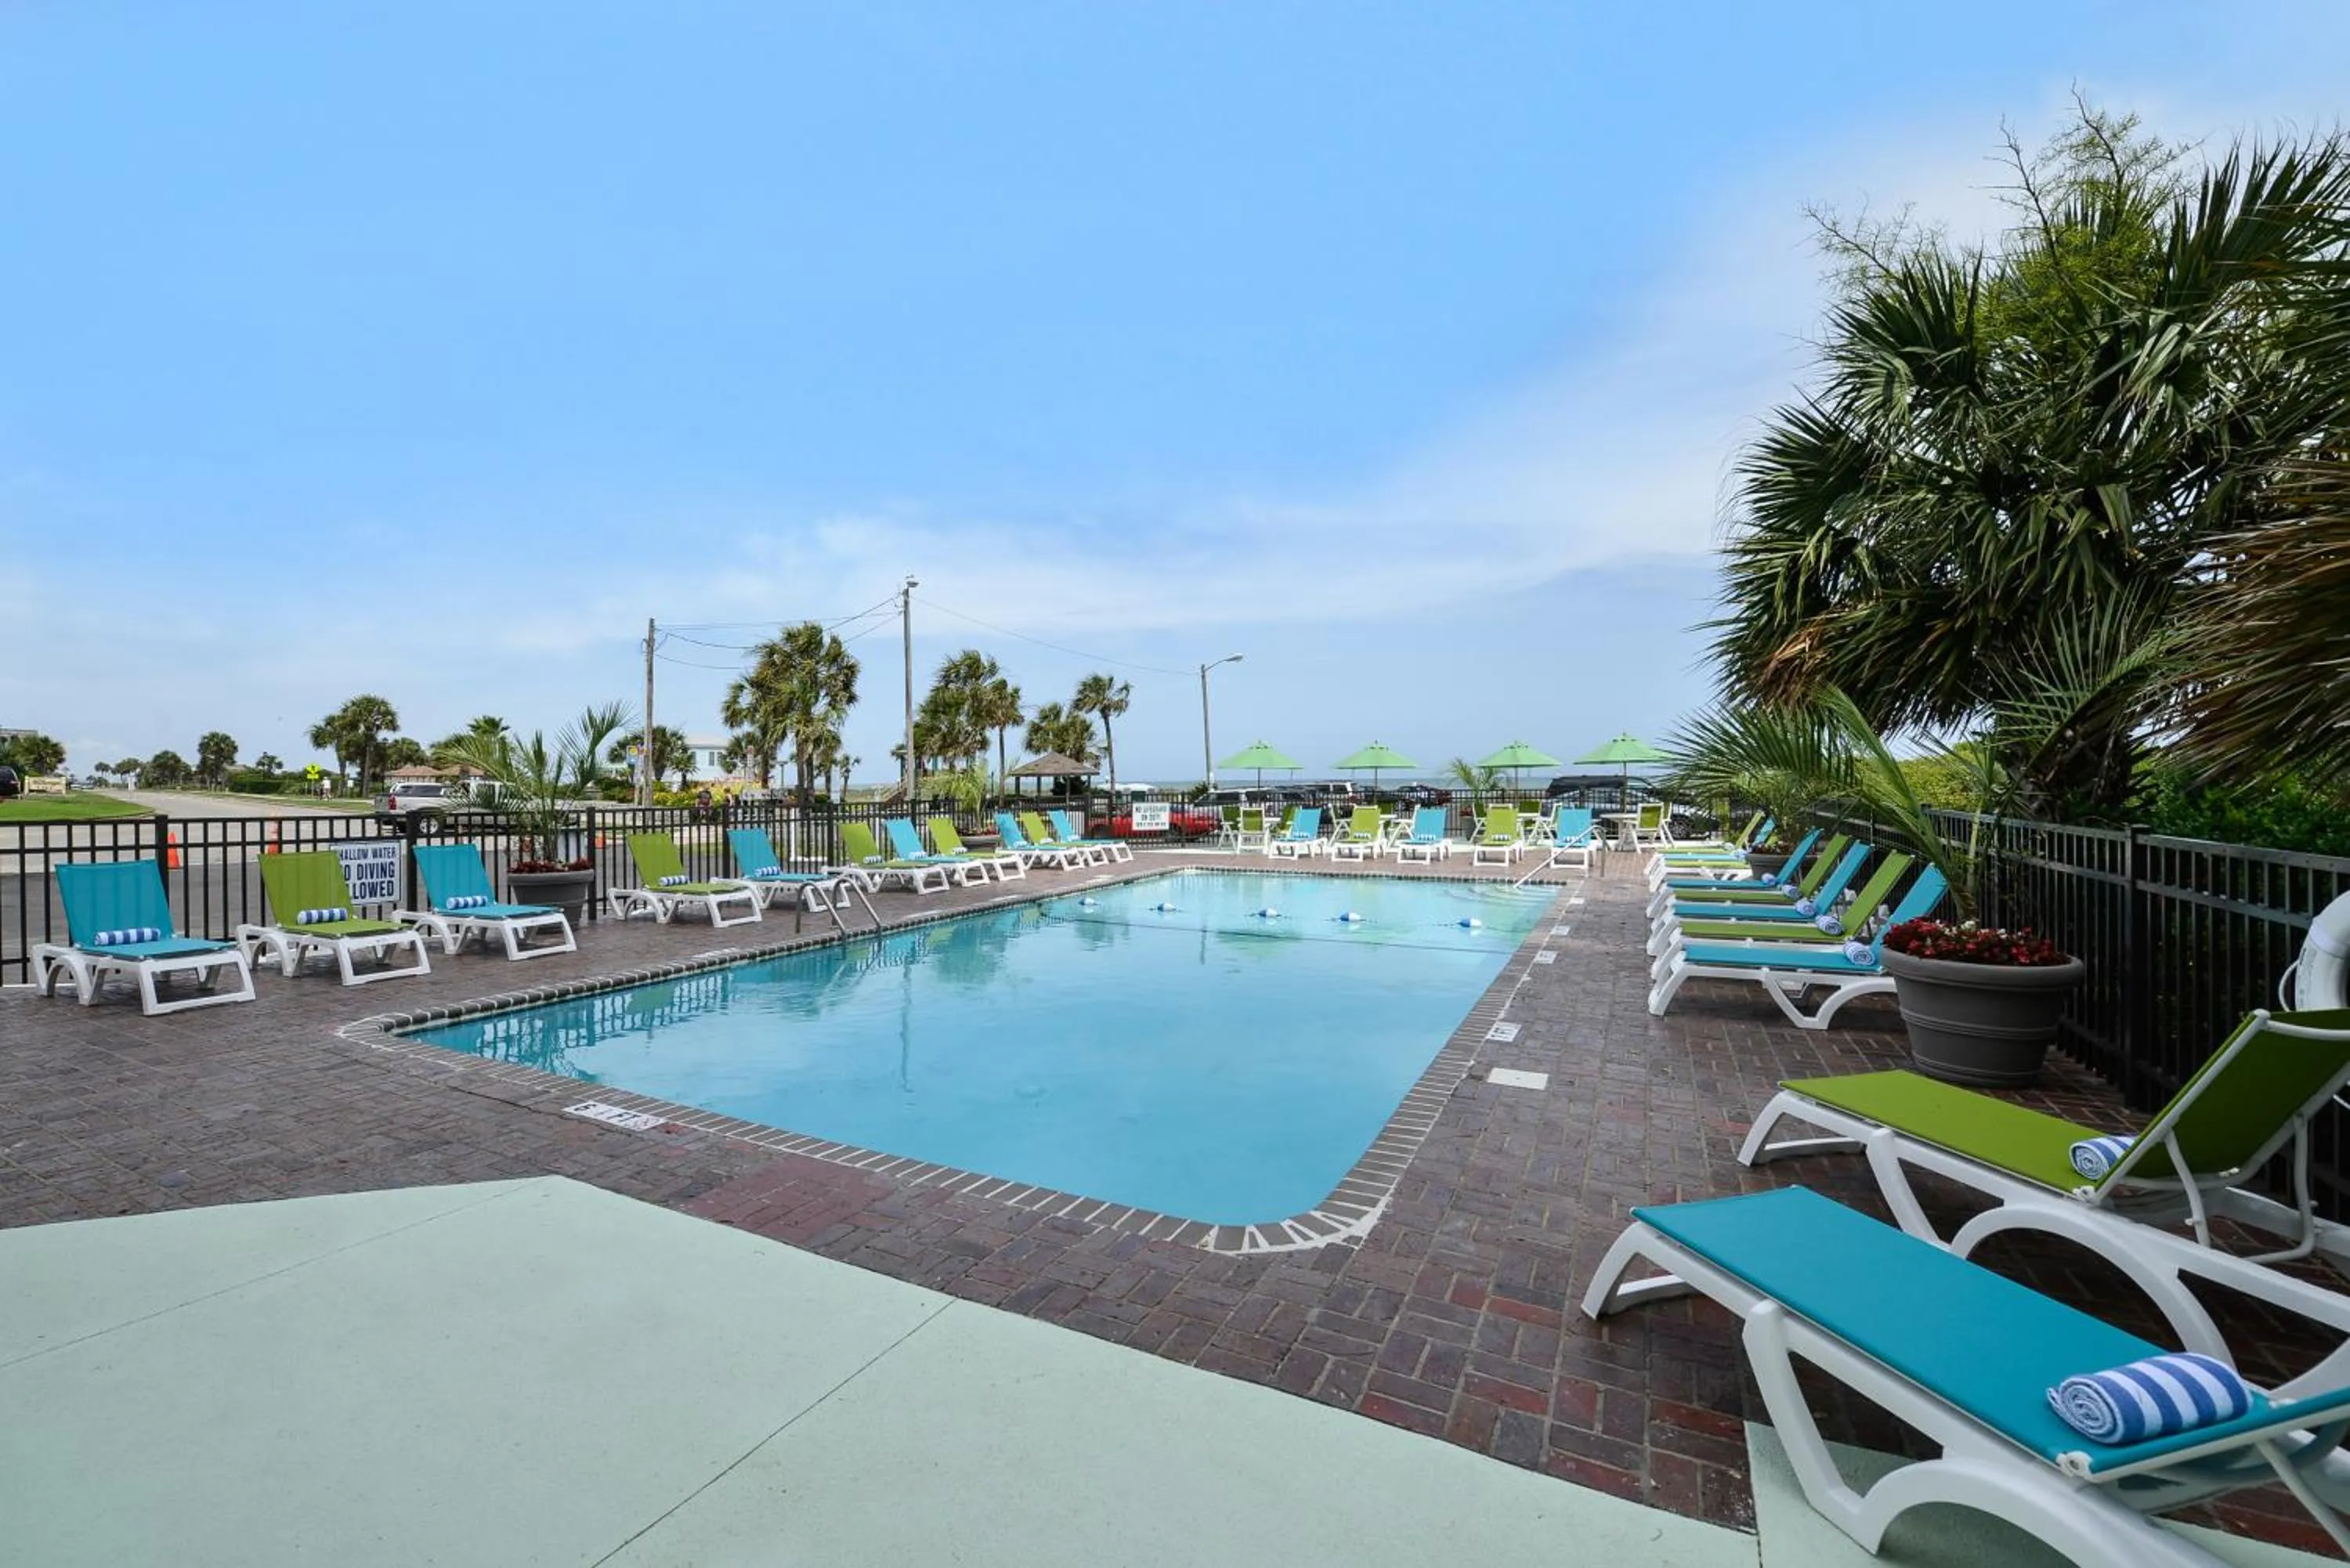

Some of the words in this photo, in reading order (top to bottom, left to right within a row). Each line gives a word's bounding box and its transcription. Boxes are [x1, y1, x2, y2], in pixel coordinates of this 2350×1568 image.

[339, 848, 369, 861] HALLOW
[371, 847, 396, 859] WATER
[356, 861, 395, 881] DIVING
[347, 880, 394, 900] LOWED
